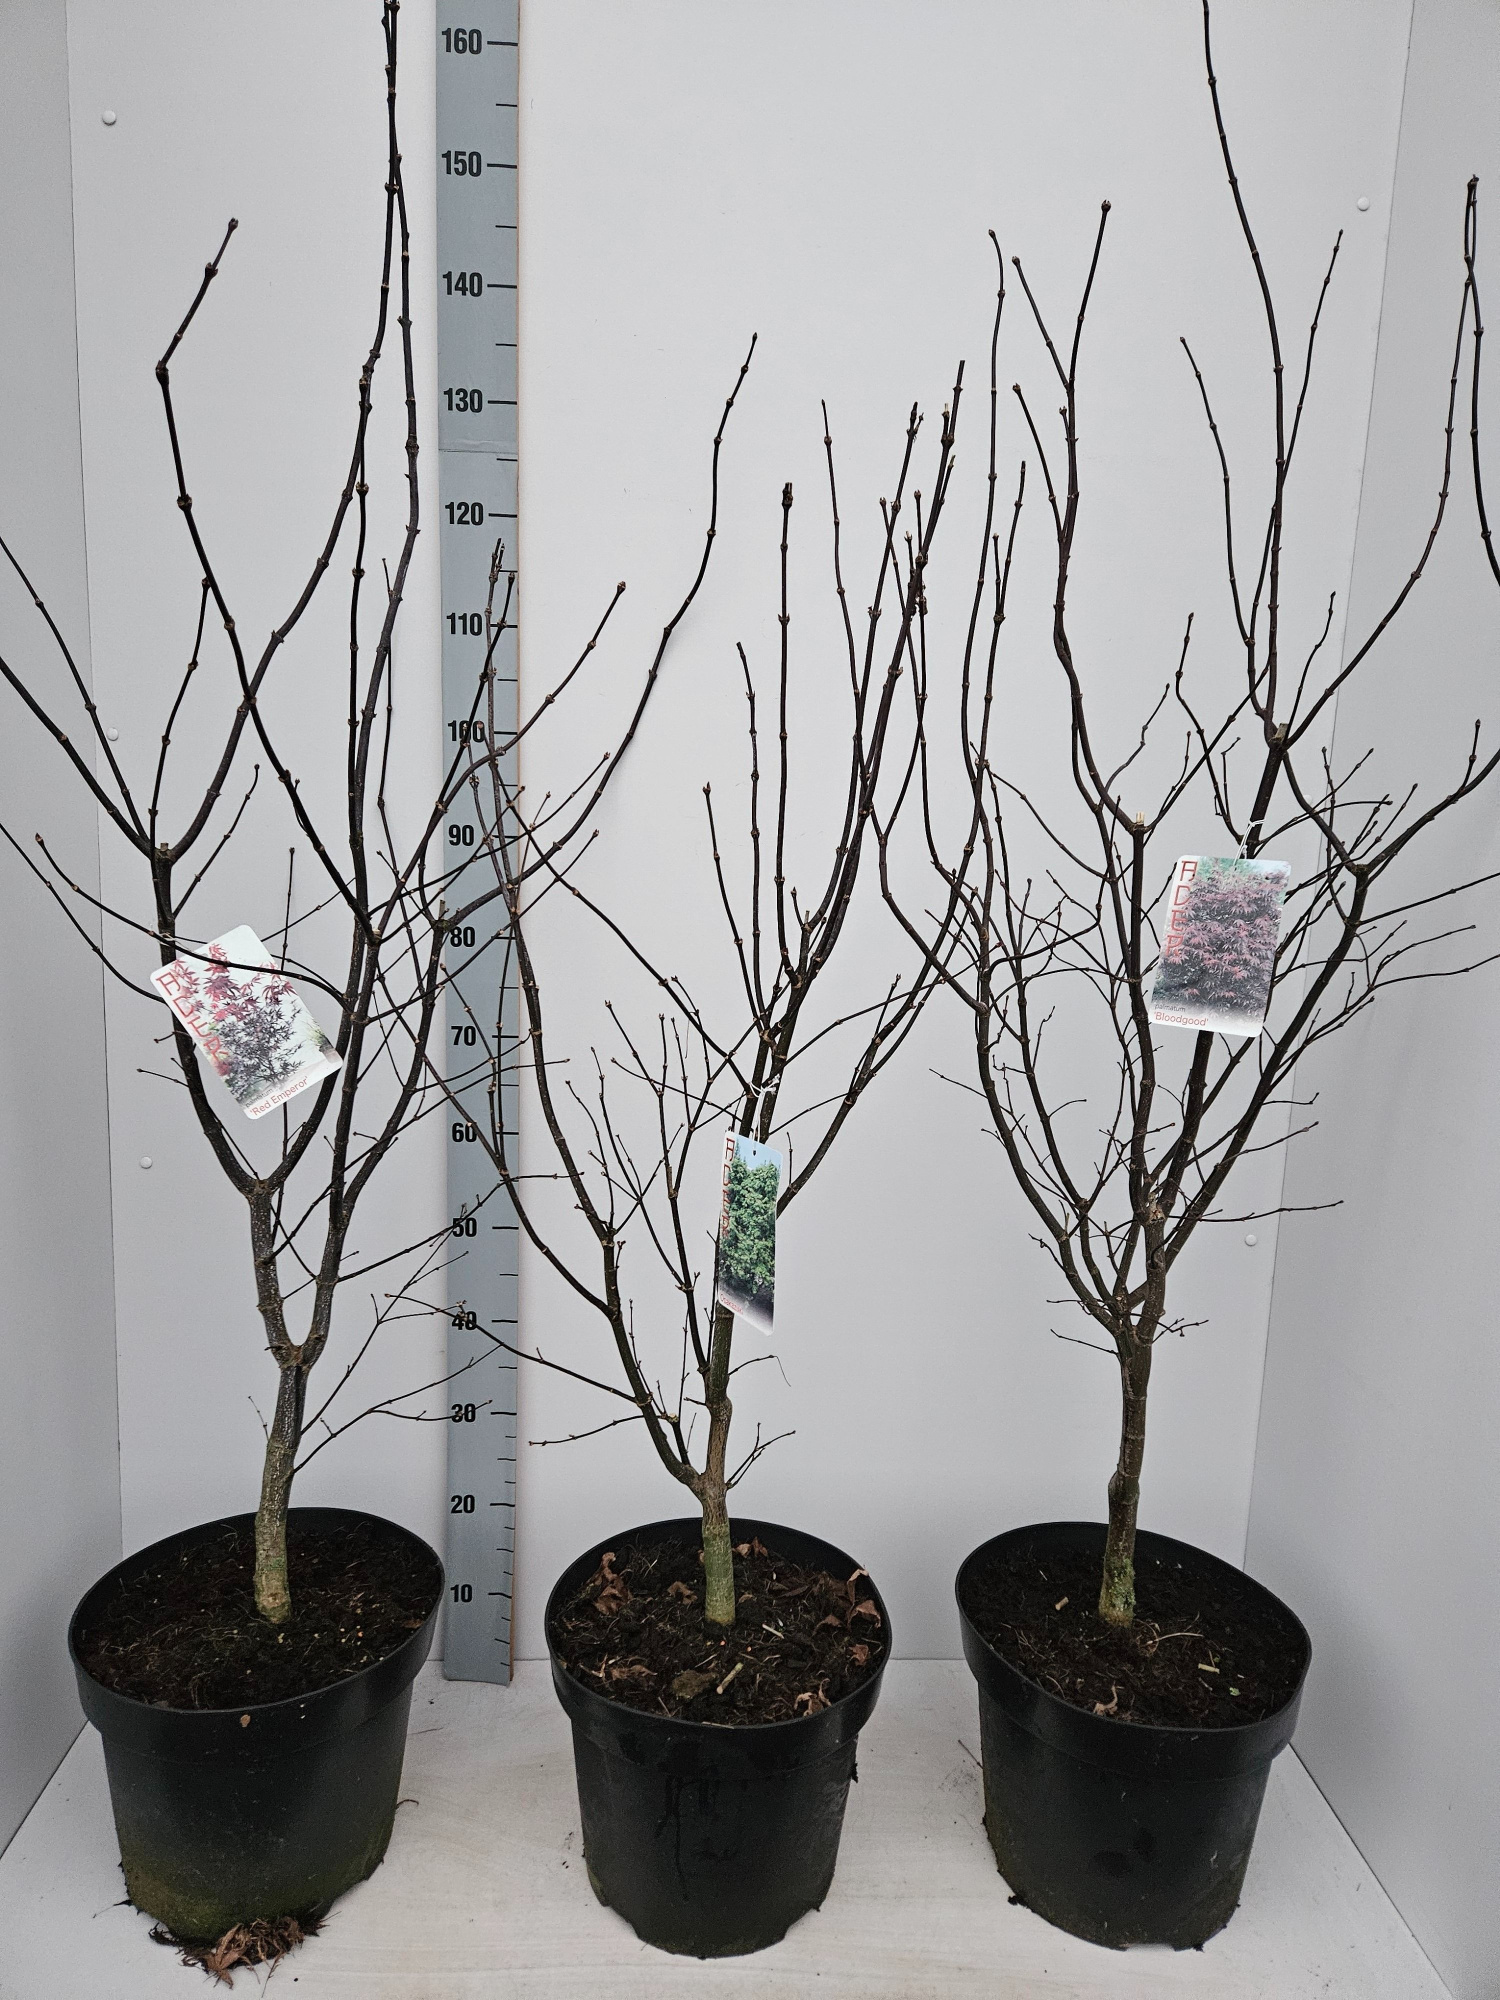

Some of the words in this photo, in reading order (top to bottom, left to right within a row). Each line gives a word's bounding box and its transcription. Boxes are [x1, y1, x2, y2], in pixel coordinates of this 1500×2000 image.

[441, 27, 482, 55] 160
[441, 149, 482, 178] 150
[442, 270, 483, 298] 140
[443, 387, 483, 414] 130
[444, 501, 484, 526] 120
[446, 612, 483, 637] 110
[447, 720, 485, 743] 100
[448, 824, 475, 847] 90
[450, 926, 476, 948] 80
[451, 1025, 477, 1047] 70
[451, 1122, 477, 1143] 60
[452, 1217, 478, 1238] 50
[451, 1310, 477, 1331] 40
[451, 1403, 476, 1423] 30
[450, 1494, 476, 1515] 20
[449, 1583, 473, 1604] 10
